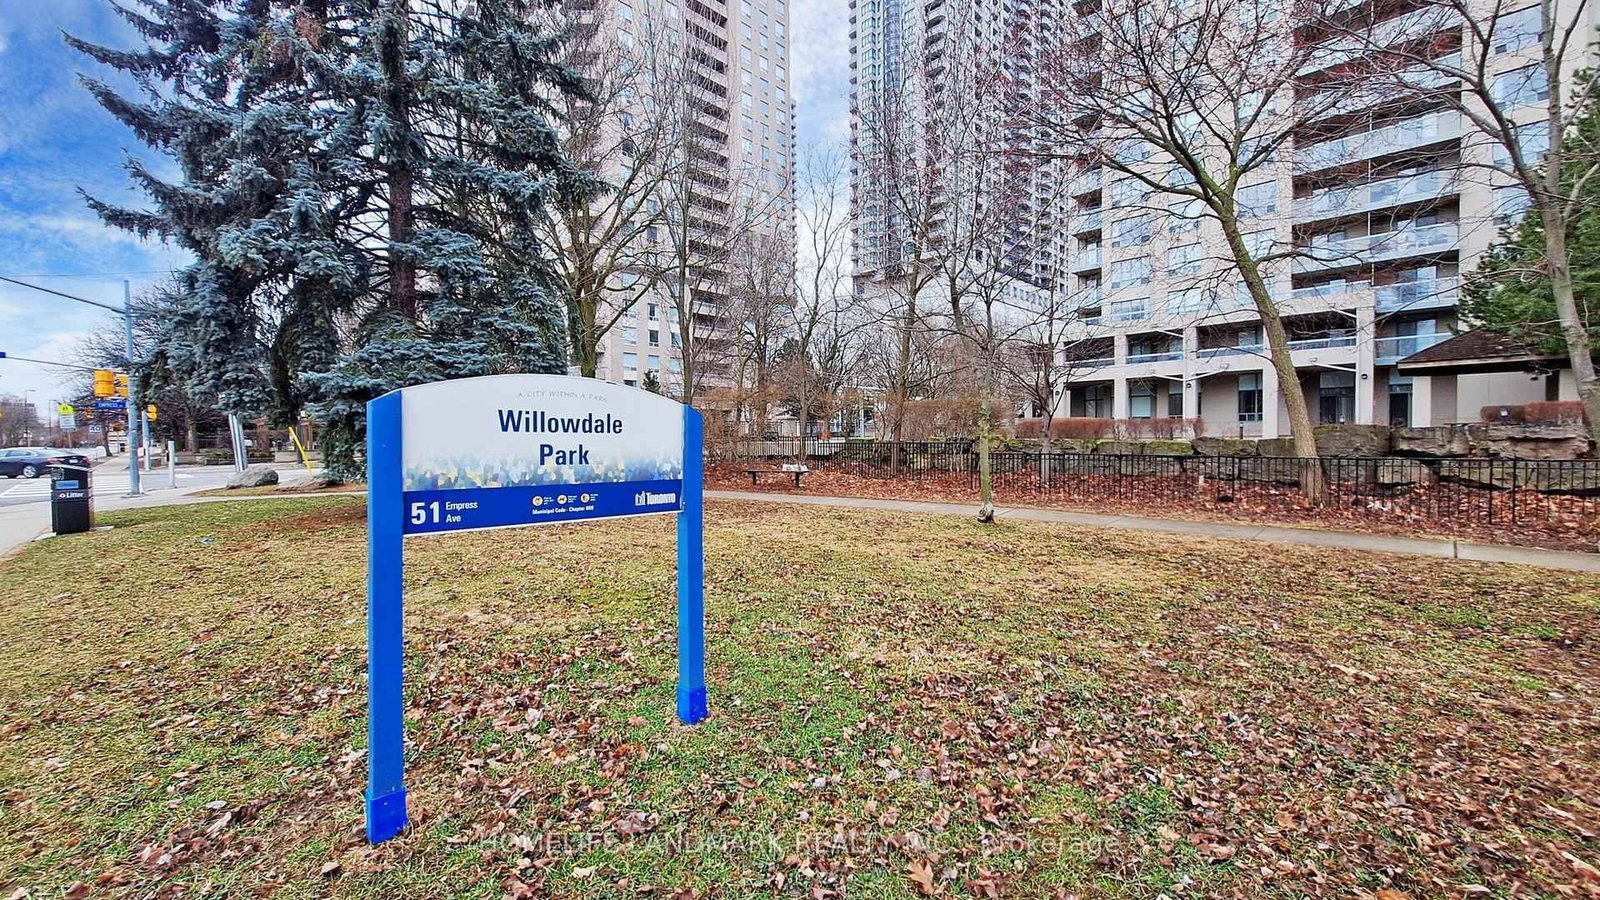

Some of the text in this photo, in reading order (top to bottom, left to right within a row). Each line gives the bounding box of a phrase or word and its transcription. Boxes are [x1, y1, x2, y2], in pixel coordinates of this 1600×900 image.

[497, 409, 624, 434] Willowdale
[539, 444, 590, 466] Park
[411, 501, 440, 525] 51
[445, 501, 478, 511] Empress
[445, 513, 462, 523] Ave
